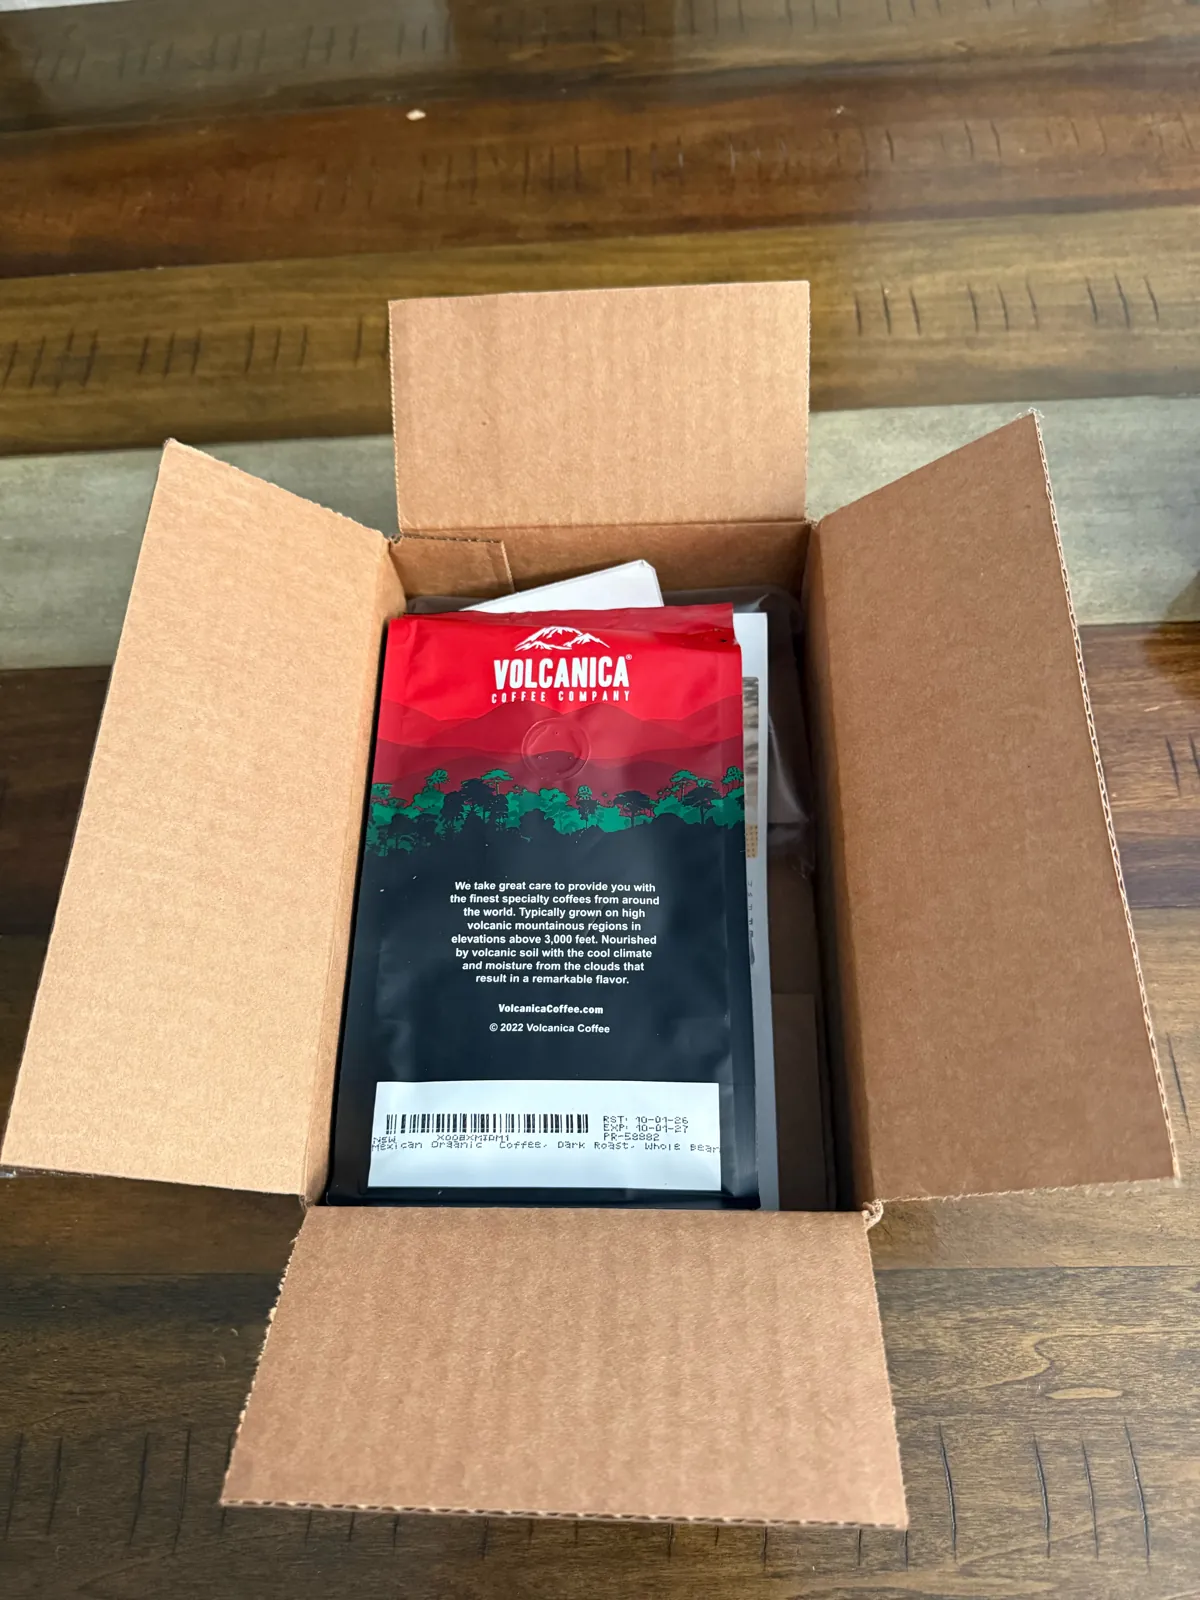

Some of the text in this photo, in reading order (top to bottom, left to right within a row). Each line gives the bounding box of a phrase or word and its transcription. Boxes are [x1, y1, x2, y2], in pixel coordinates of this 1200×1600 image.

[491, 690, 630, 704] COFFEE COMPANY
[455, 880, 655, 894] We take great care to provide you with
[450, 893, 659, 906] the finest specialty coffees from around
[463, 906, 645, 920] the world. Typically grown on high
[467, 920, 641, 933] volcanic mountainous regions in
[451, 933, 656, 946] elevations above 3,000 feet. Nourished
[456, 947, 652, 960] by volcanic soil with the cool climate
[462, 960, 644, 972] and moisture from the clouds that
[476, 973, 629, 985] result in a remarkable flavor.
[499, 1003, 603, 1015] VolcanicaCoffee.com
[500, 1022, 523, 1032] 2022
[527, 1022, 574, 1033] Volcanica
[578, 1023, 610, 1034] Coffee
[603, 1115, 628, 1124] RST:
[603, 1124, 628, 1132] EXP:
[371, 1141, 423, 1151] Mexican
[431, 1141, 482, 1149] Organic
[557, 1141, 585, 1149] Dark
[645, 1142, 681, 1151] Whole
